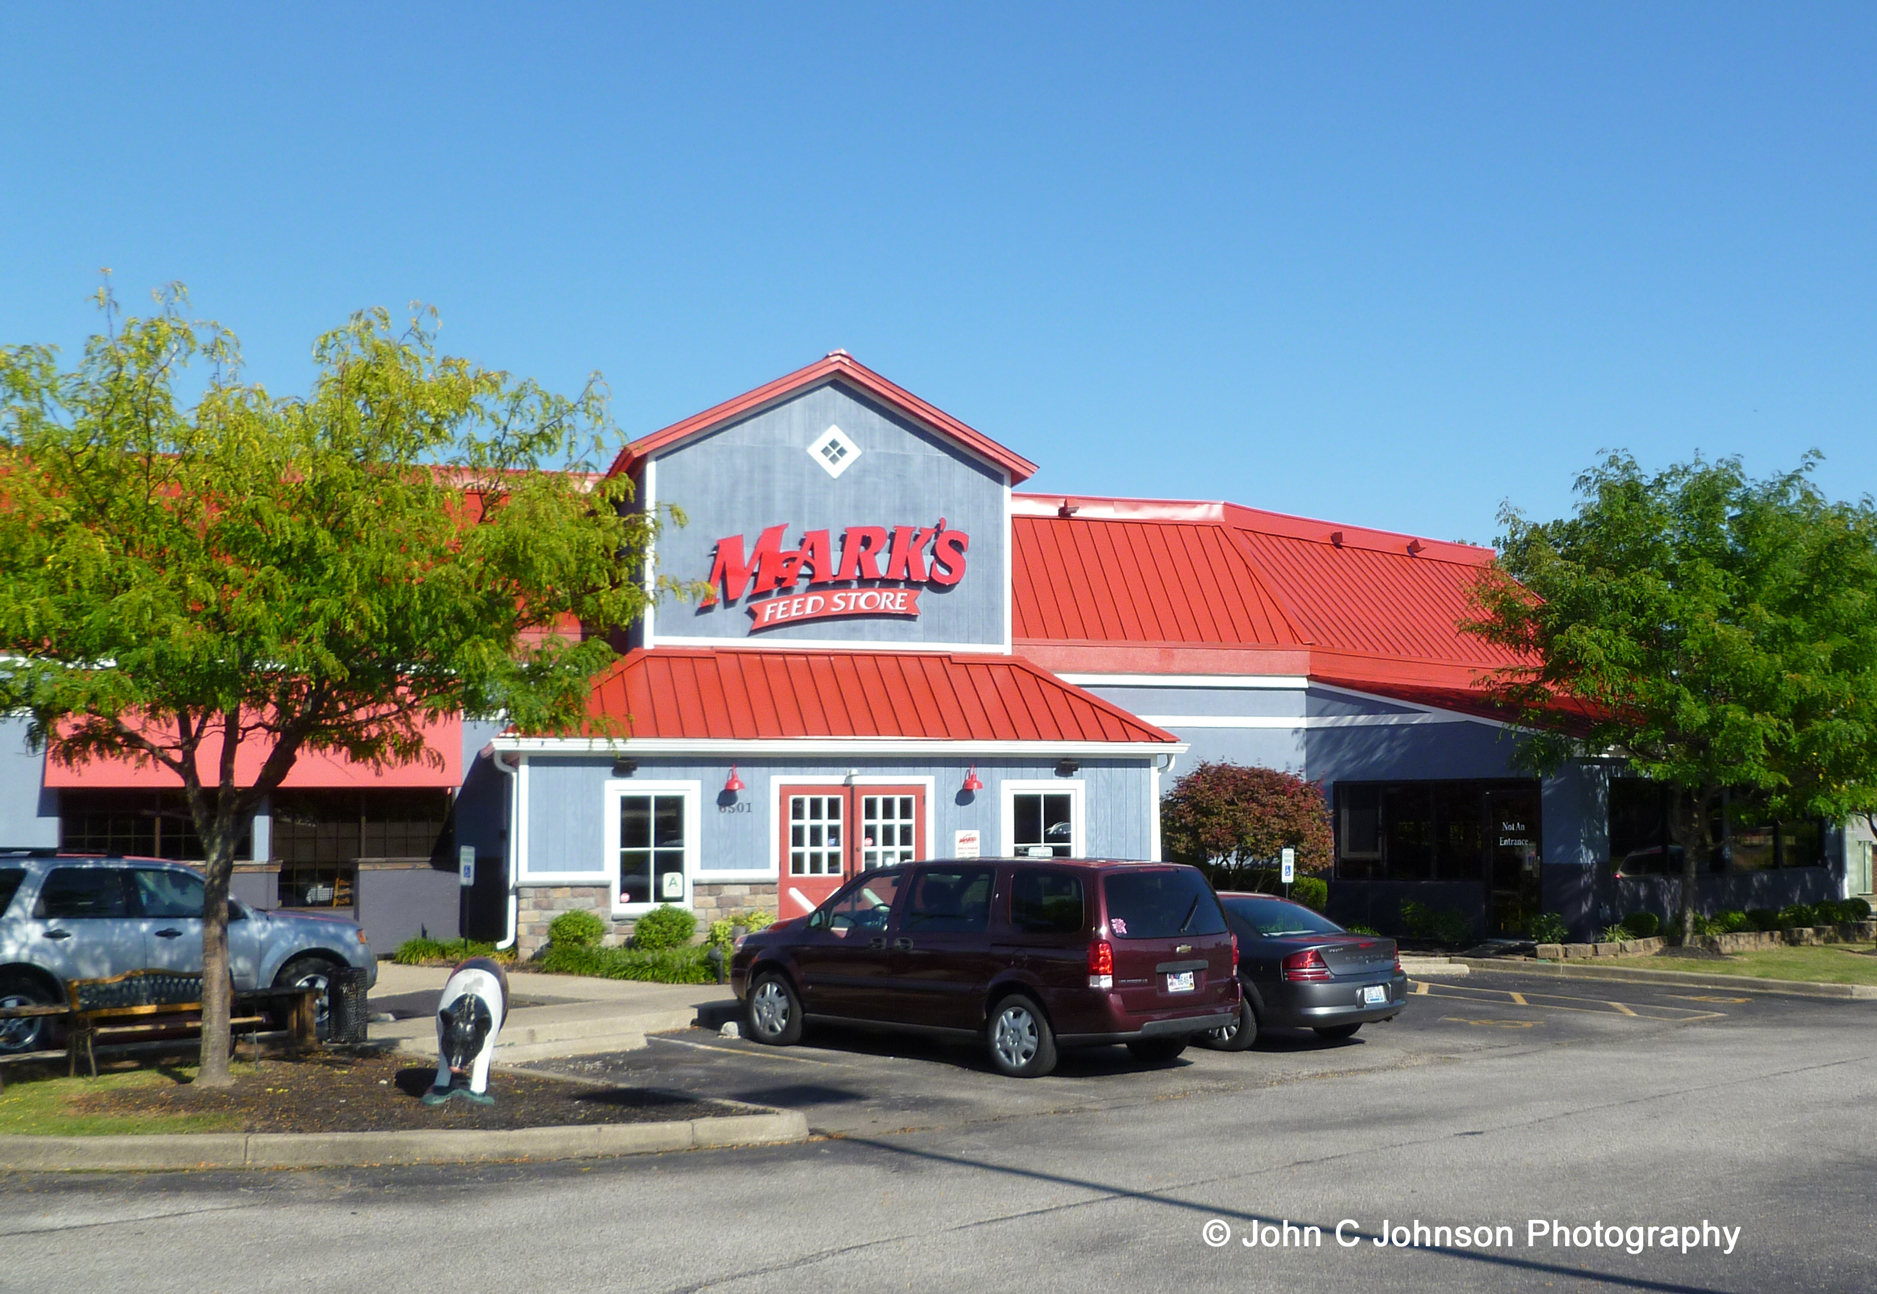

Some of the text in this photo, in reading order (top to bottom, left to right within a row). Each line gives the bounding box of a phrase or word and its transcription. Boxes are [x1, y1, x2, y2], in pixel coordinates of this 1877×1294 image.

[699, 517, 970, 609] MARK'S
[763, 591, 909, 623] FEED STORE
[1502, 821, 1526, 831] Not An
[1499, 836, 1529, 846] Entrance
[668, 876, 678, 887] A
